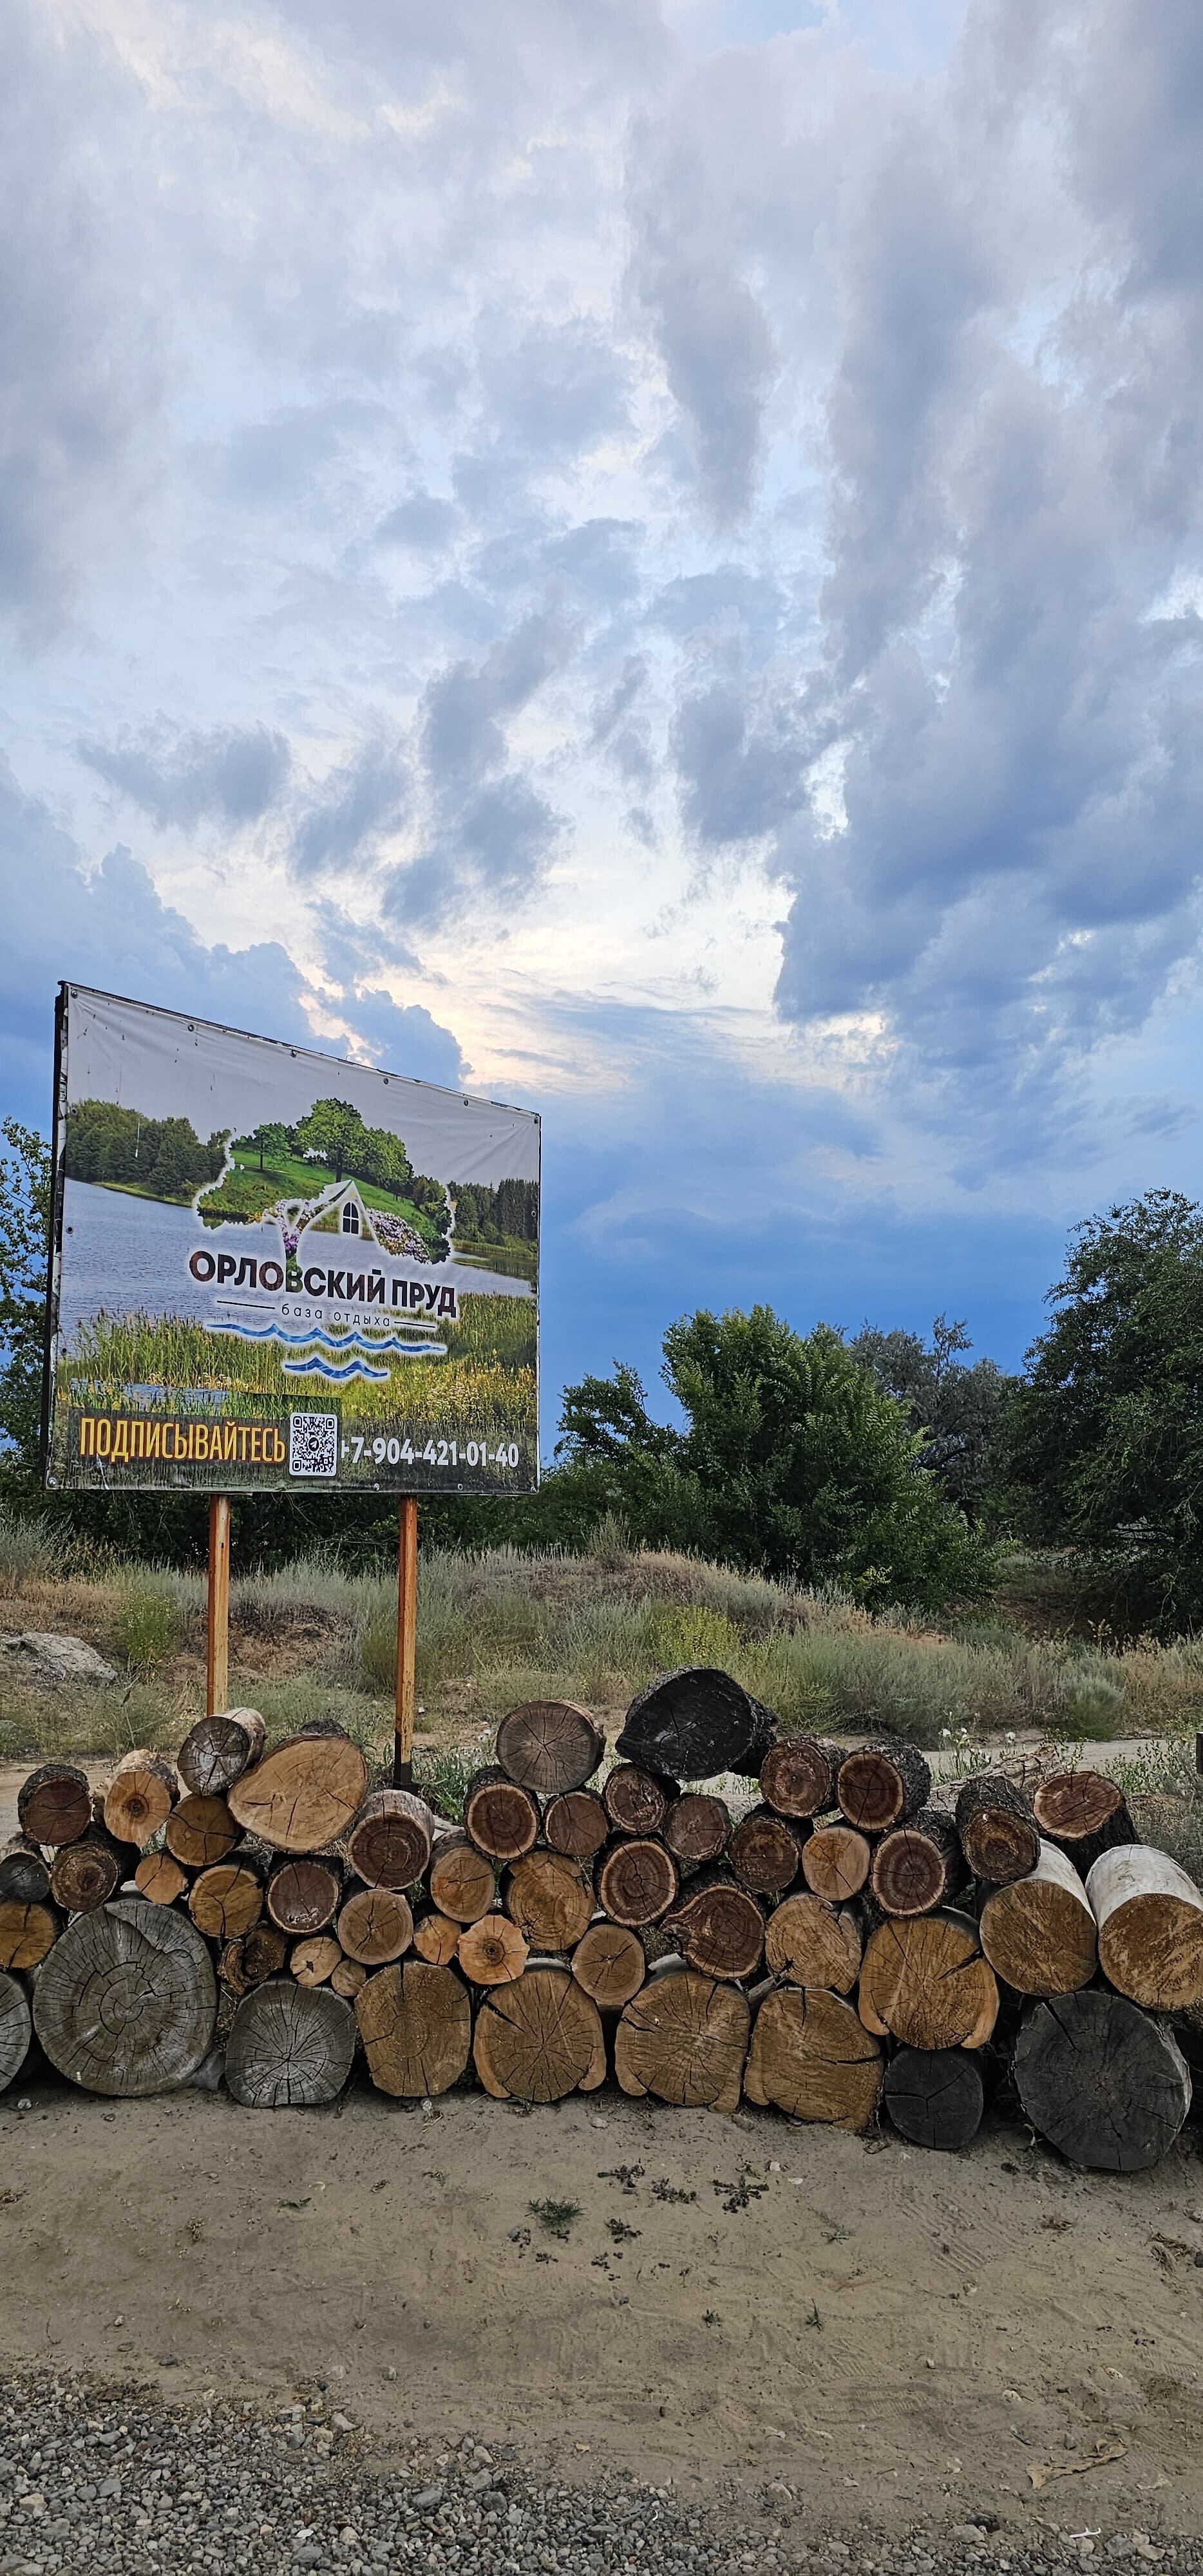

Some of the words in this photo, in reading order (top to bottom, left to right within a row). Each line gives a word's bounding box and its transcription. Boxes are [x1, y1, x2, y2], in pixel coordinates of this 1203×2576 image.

[189, 1251, 386, 1304] ОРЛОВСКИЙ
[392, 1278, 457, 1318] ПРУД
[281, 1303, 323, 1320] база
[334, 1312, 390, 1327] отдыха
[79, 1417, 286, 1463] ПОДПИСЫВАЙТЕСЬ
